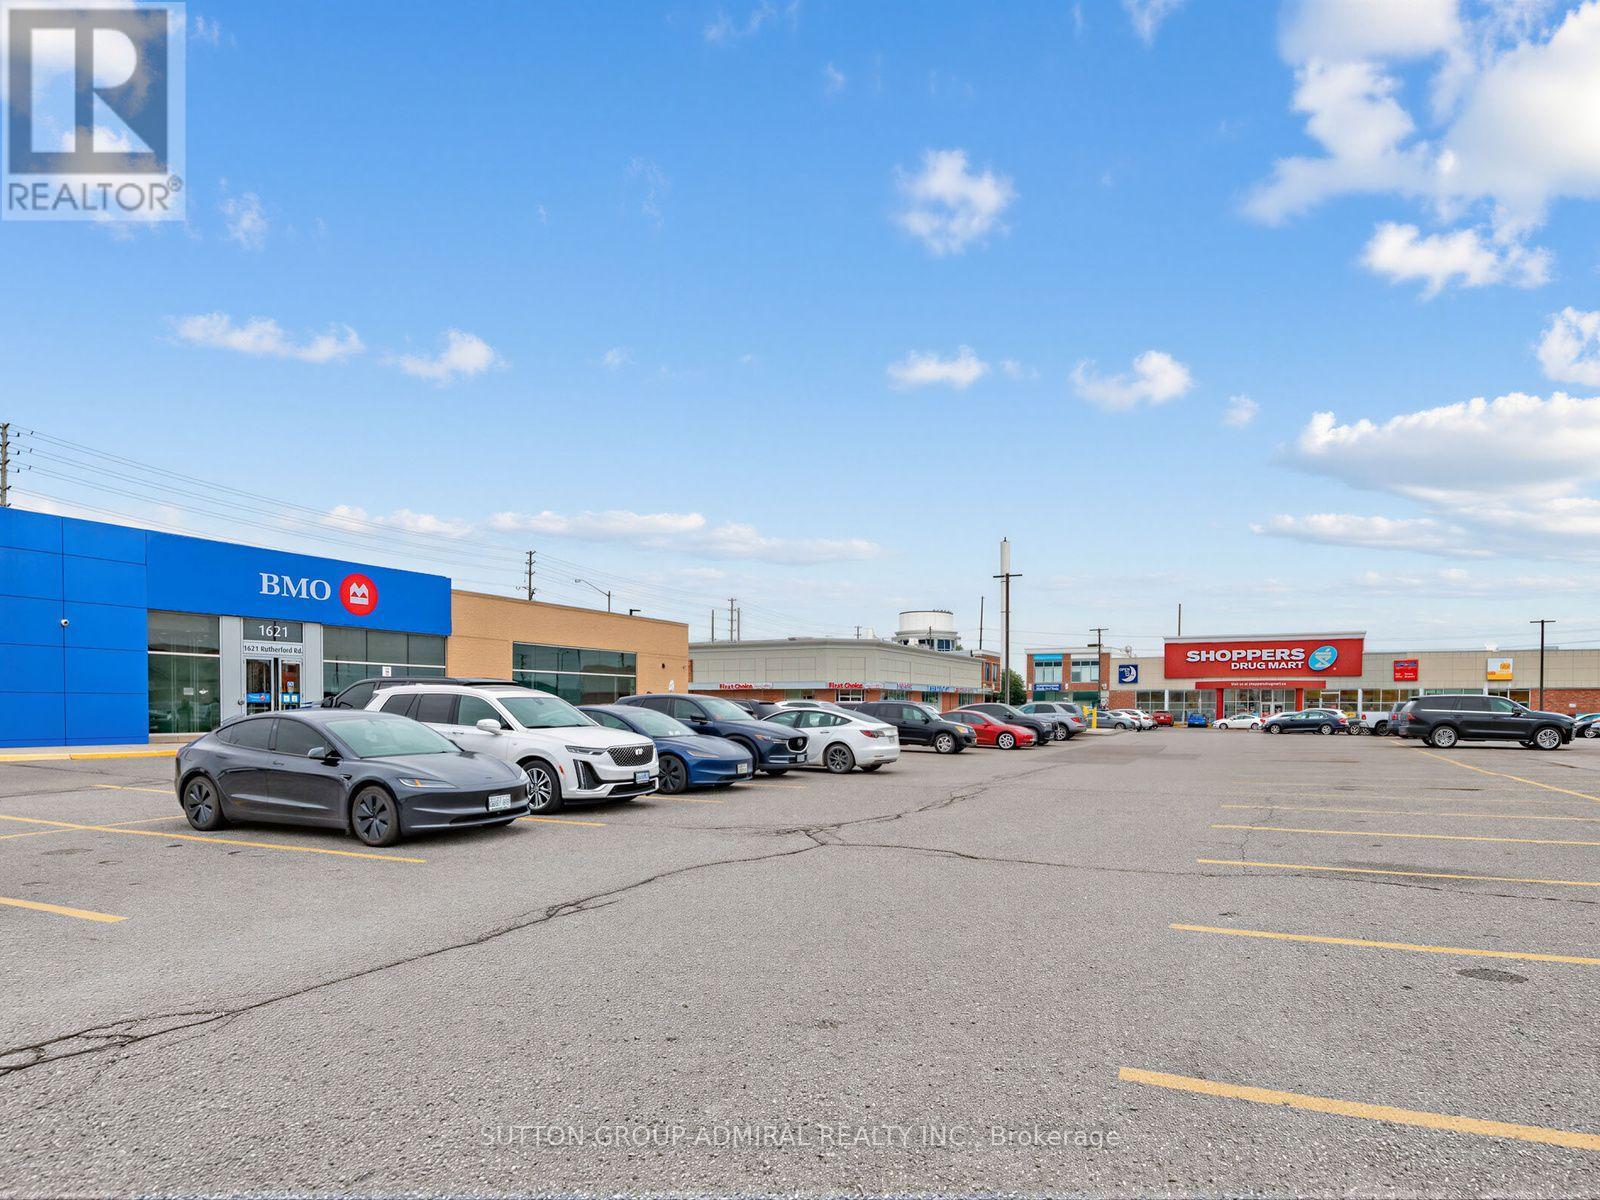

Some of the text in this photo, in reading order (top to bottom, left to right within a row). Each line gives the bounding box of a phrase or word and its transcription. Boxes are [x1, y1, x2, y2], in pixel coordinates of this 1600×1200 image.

[259, 572, 332, 601] BMO
[259, 625, 288, 638] 1621
[260, 645, 293, 654] Rutherford
[1186, 647, 1306, 662] SHOPPERS
[1231, 661, 1305, 670] DRUG MART
[828, 681, 843, 689] First
[844, 681, 863, 689] Choice
